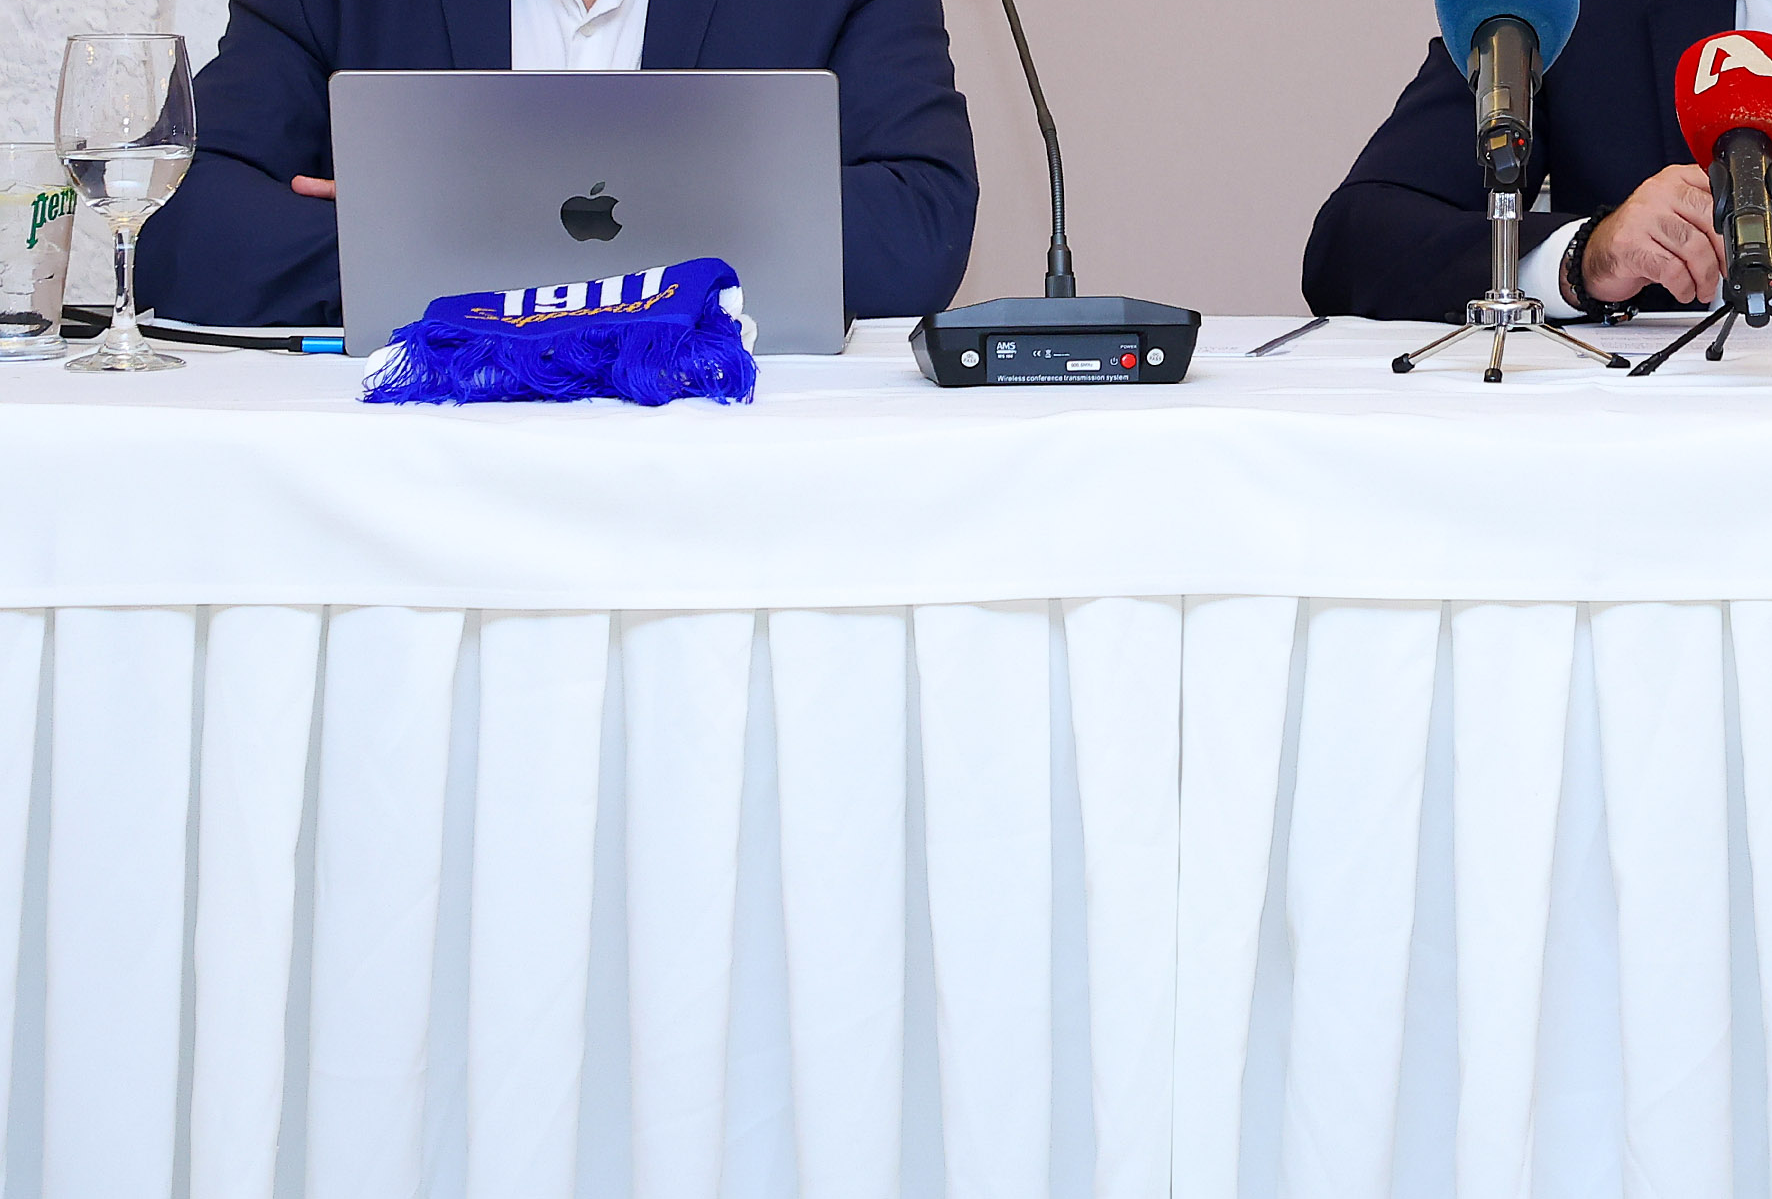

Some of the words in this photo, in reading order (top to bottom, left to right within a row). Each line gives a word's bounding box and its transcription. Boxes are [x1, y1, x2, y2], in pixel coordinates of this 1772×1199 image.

[494, 266, 668, 317] 1911
[996, 341, 1016, 350] AMS
[1063, 374, 1105, 382] transmission
[1106, 374, 1129, 382] system
